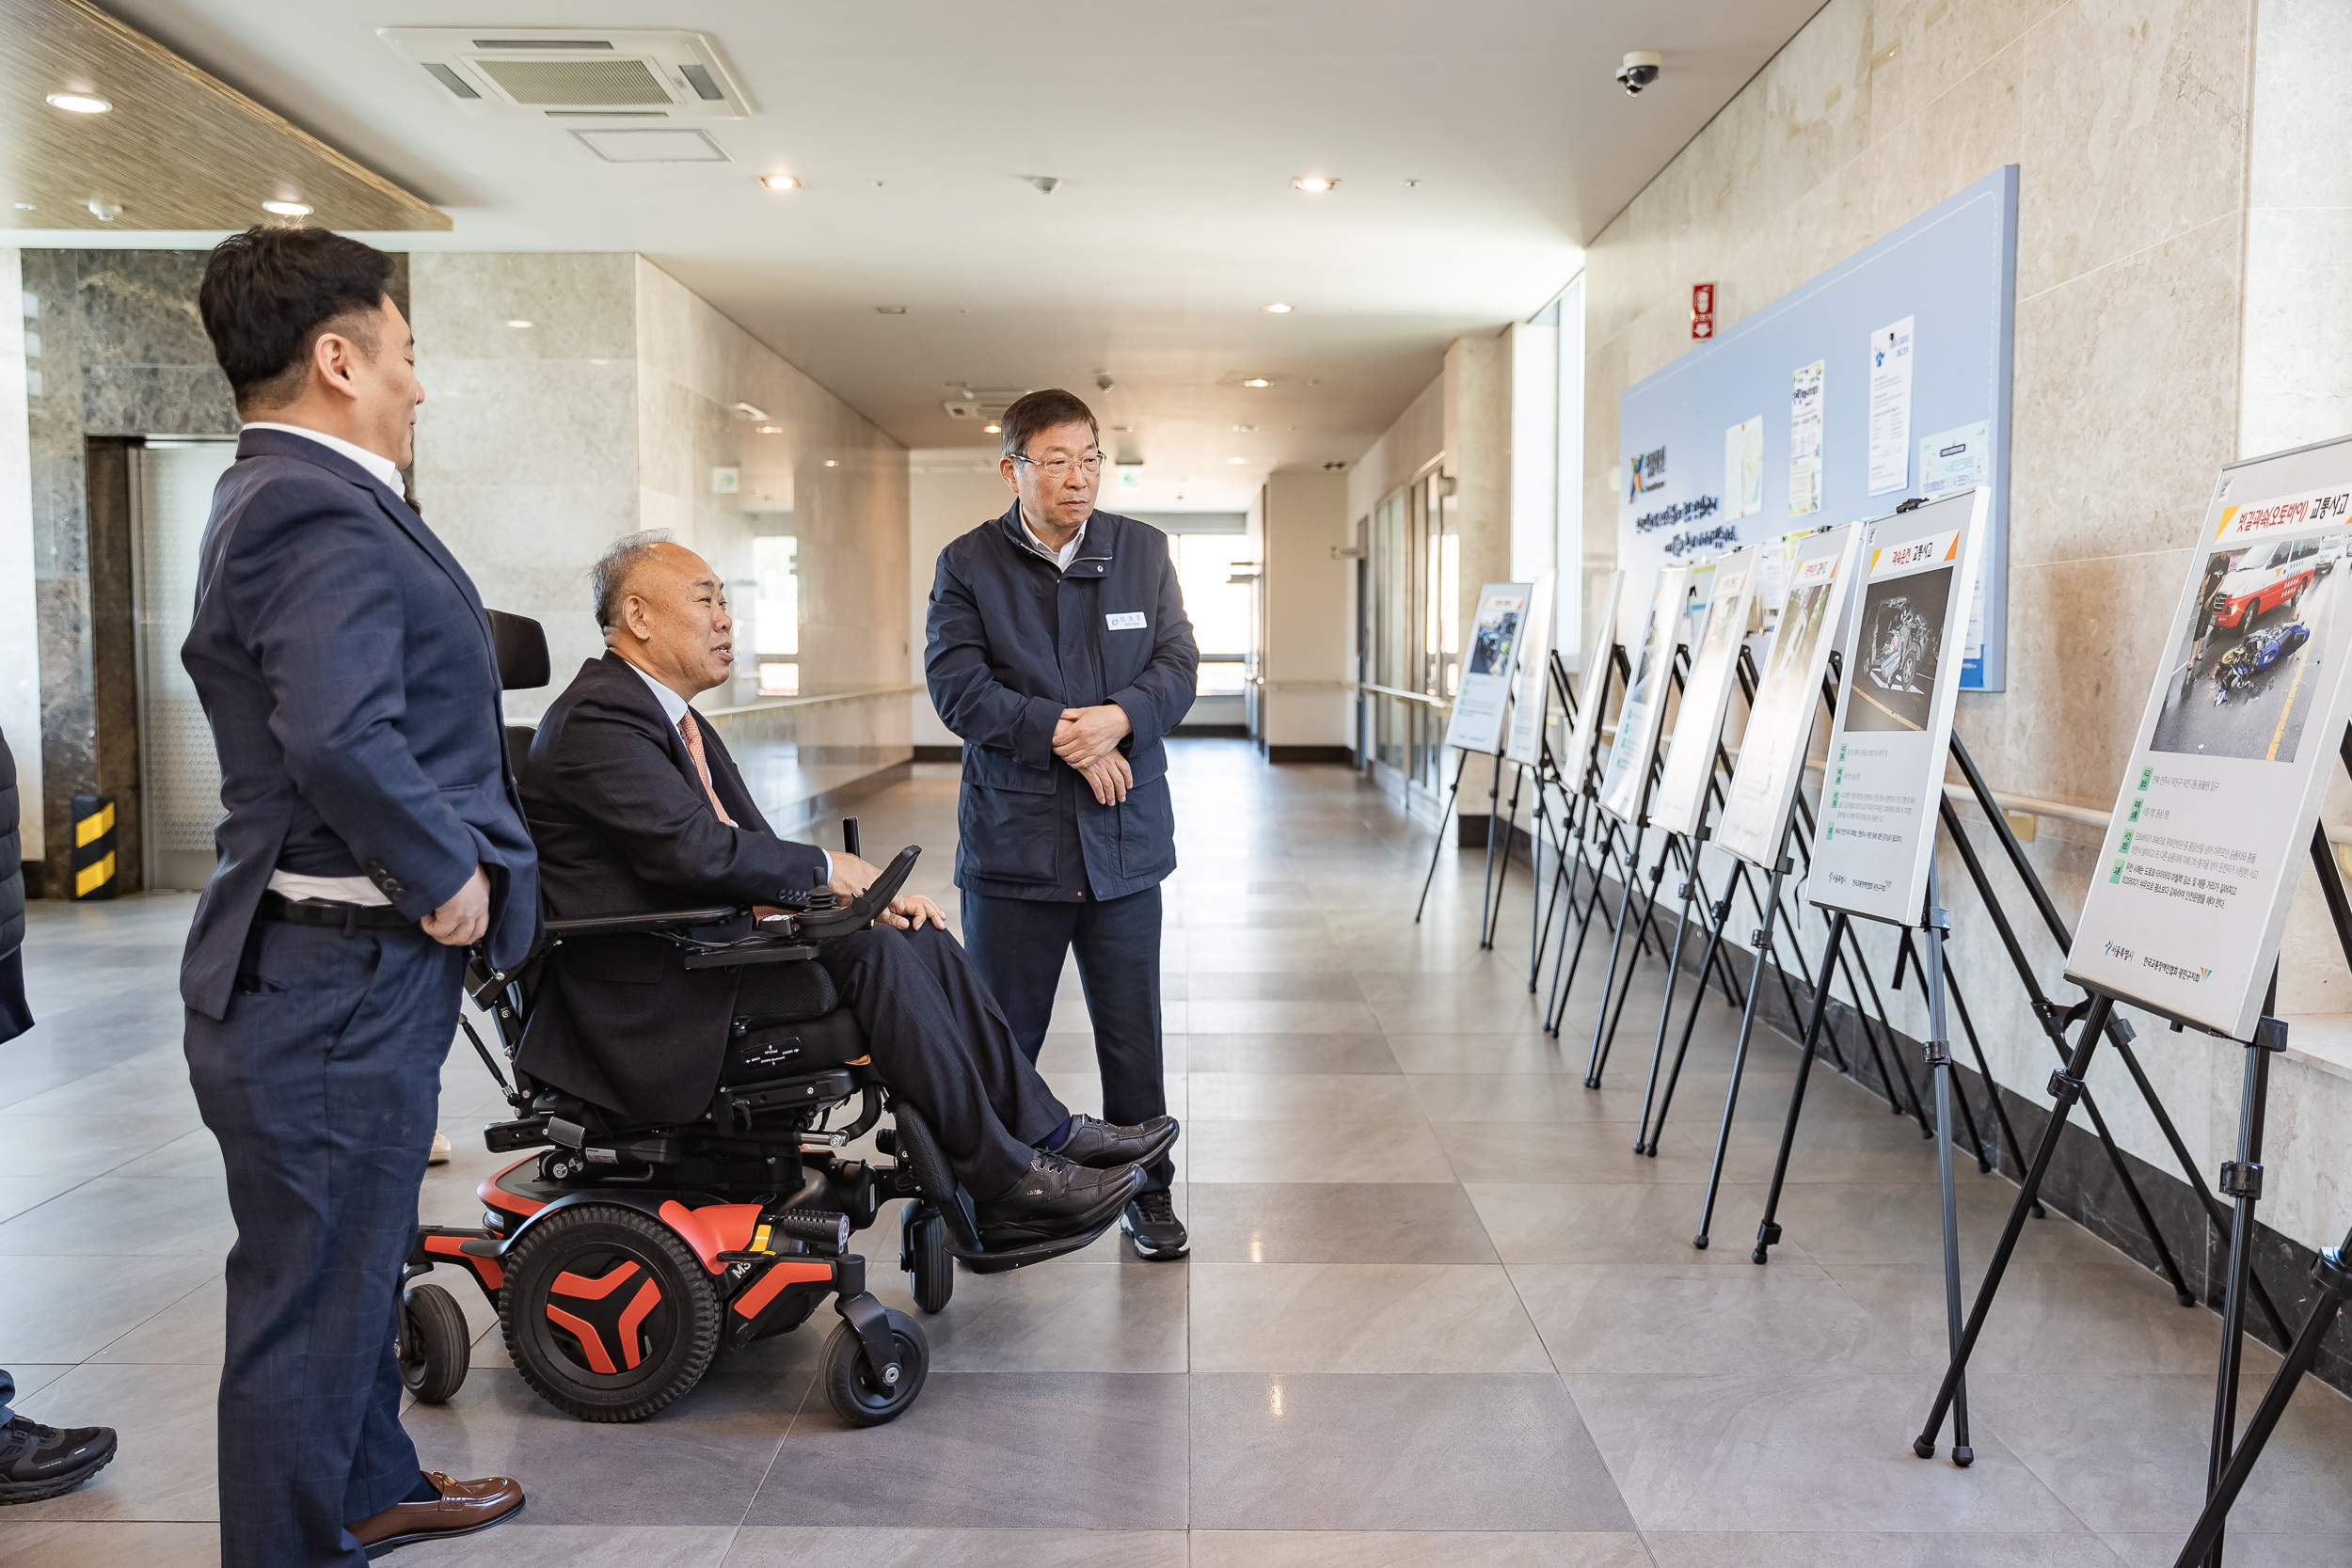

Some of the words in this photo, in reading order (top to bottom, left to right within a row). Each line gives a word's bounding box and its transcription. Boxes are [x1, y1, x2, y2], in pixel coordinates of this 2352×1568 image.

[2236, 500, 2309, 532] 빗길과속(오토바이)
[2310, 494, 2350, 519] 교통사고
[1892, 547, 1911, 566] 과속운전
[1913, 542, 1933, 561] 교통사고
[2144, 867, 2155, 877] 도로와
[2155, 869, 2171, 880] 타이어의
[2171, 873, 2184, 883] 마찰력
[2183, 875, 2191, 885] 감소
[2206, 880, 2219, 892] 거리가
[2219, 884, 2237, 895] 길어지고
[2249, 869, 2258, 879] 사고
[2154, 883, 2169, 894] 평소보다
[2185, 890, 2205, 904] 안전운행을
[2111, 944, 2134, 962] 서울특별시
[2143, 957, 2178, 975] 한국교통장애인협회
[2179, 968, 2201, 982] 광진구지회
[732, 1263, 752, 1279] M3
